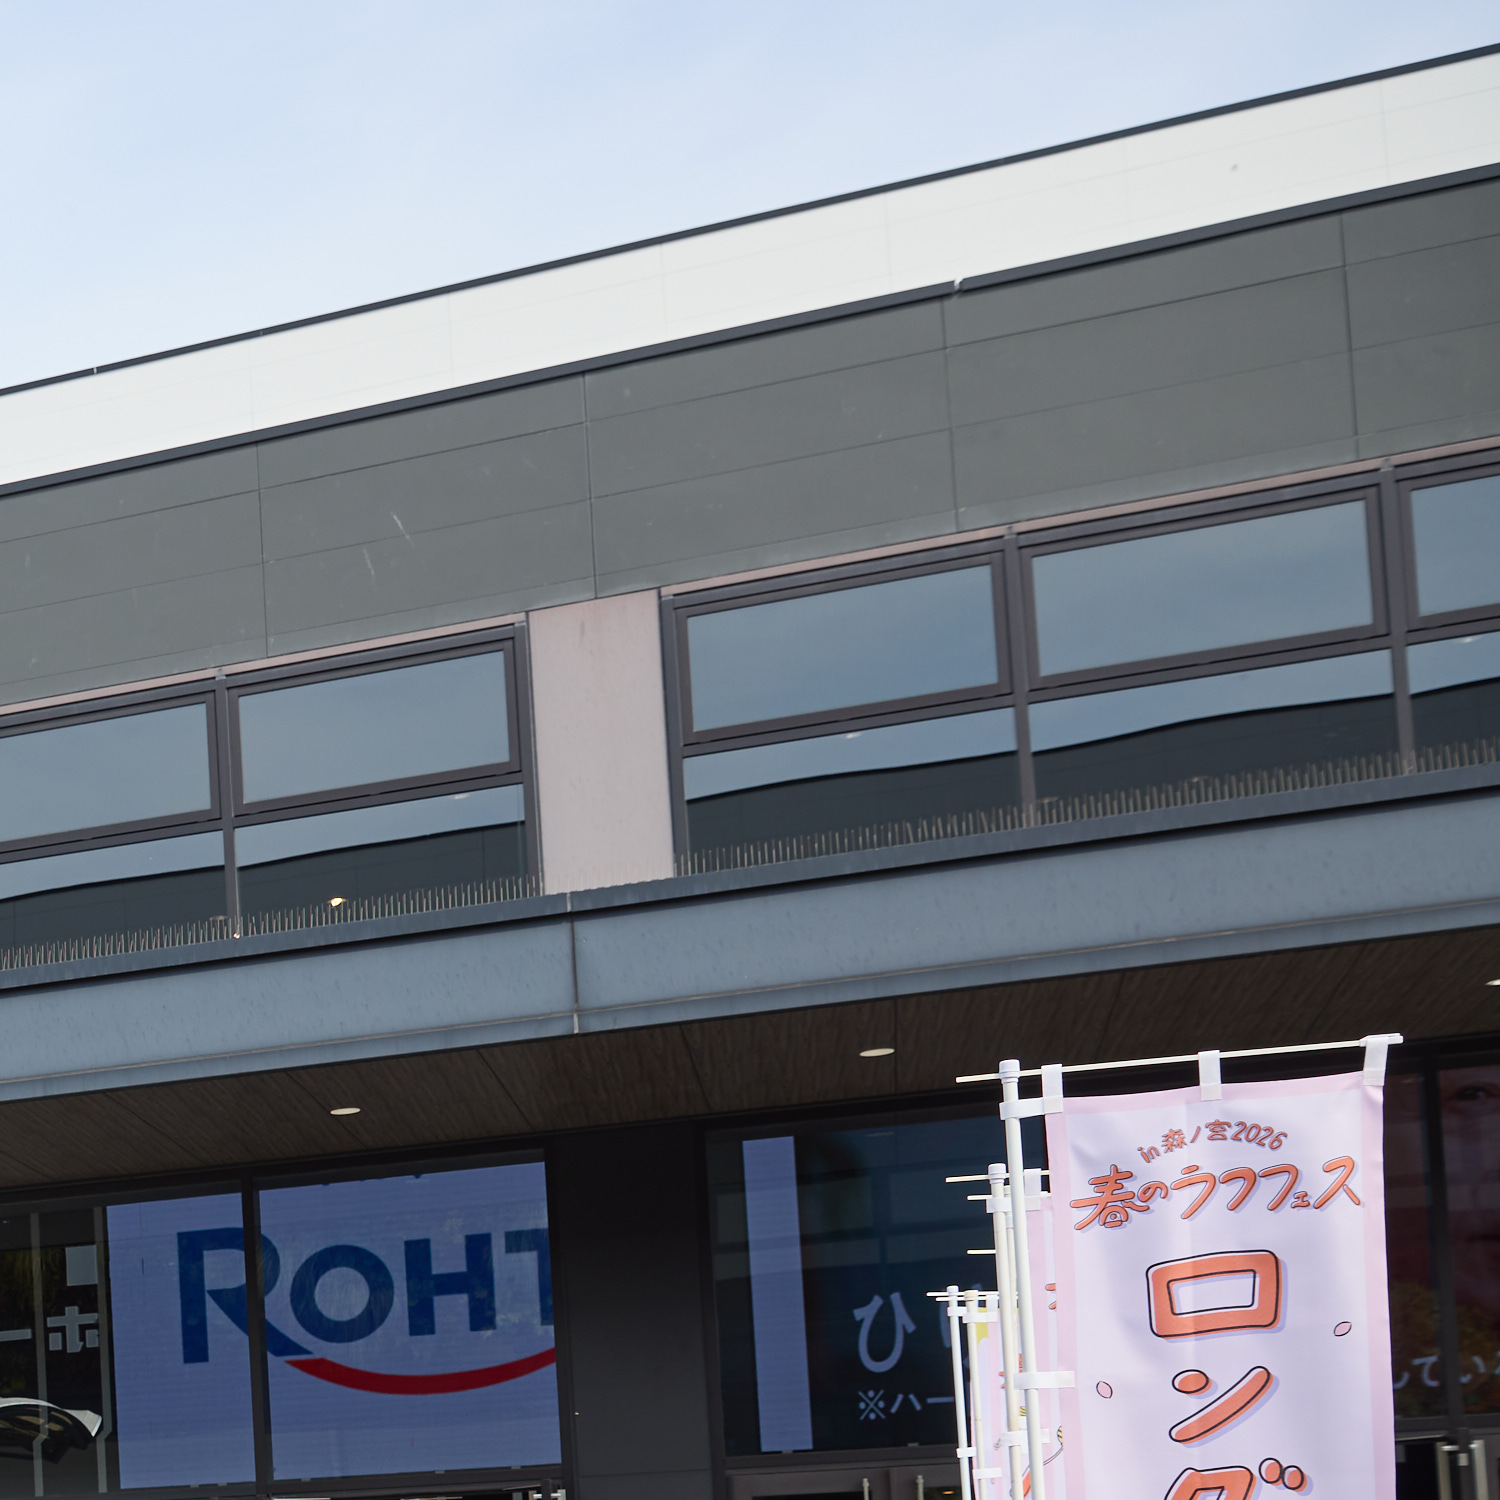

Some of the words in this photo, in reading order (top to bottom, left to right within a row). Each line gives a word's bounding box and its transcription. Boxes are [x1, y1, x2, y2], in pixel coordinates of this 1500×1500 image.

[1070, 1156, 1361, 1231] 春のラフフェス
